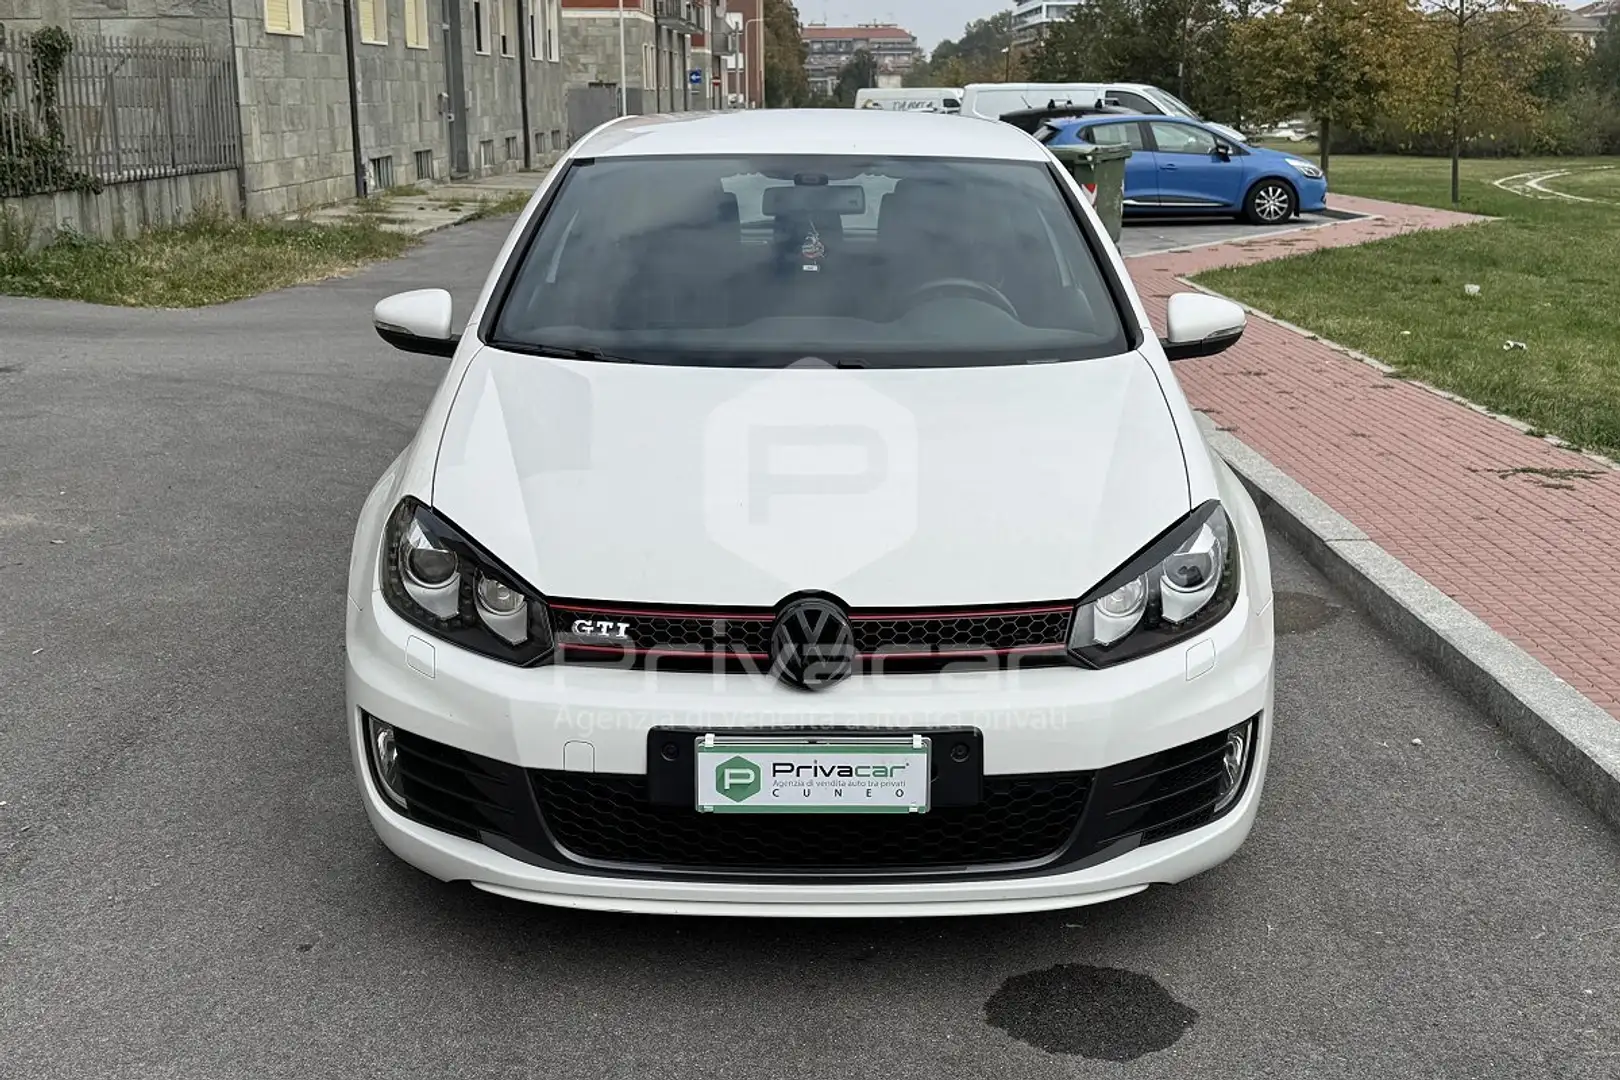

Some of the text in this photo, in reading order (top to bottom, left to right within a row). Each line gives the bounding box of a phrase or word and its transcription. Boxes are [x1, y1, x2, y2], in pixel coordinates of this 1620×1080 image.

[573, 619, 631, 638] GTI
[772, 760, 906, 777] Privacar
[724, 768, 755, 790] P
[772, 779, 805, 789] Agenzia
[807, 779, 814, 787] di
[816, 779, 846, 787] vendita
[880, 779, 906, 789] privati
[772, 789, 905, 798] CUNEO
